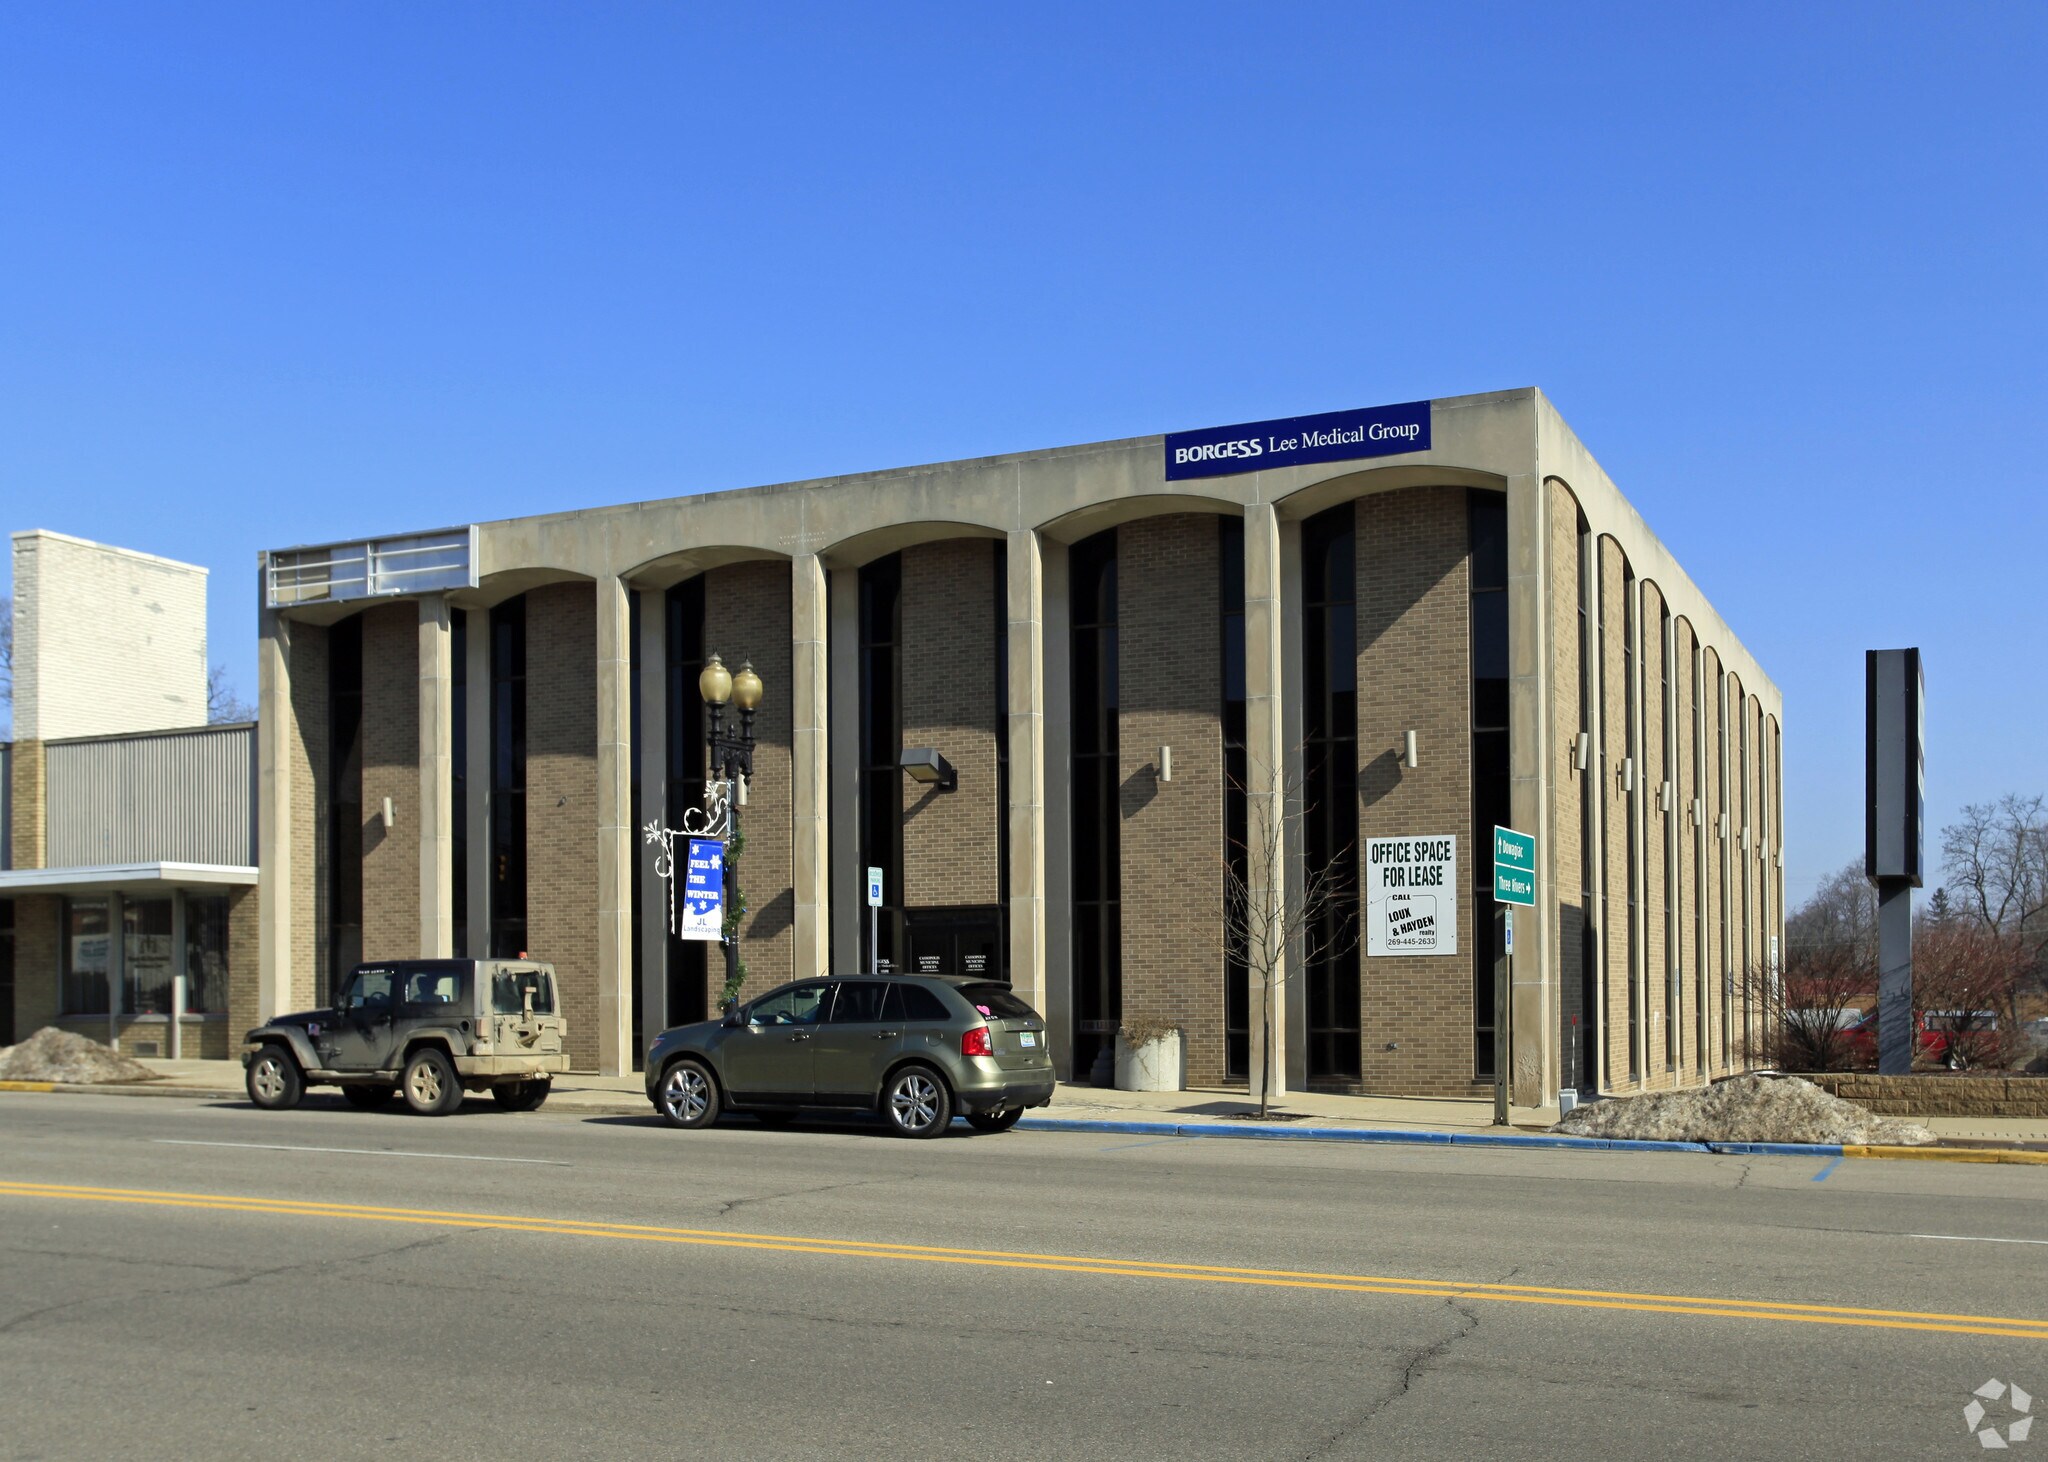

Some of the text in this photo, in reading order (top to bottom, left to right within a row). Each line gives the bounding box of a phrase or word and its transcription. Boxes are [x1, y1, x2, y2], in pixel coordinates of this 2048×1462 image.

[1175, 423, 1419, 464] BORGESS Lee Medical Group
[1372, 840, 1451, 864] OFFICE SPACE
[1503, 840, 1523, 860] Dowagiac
[690, 859, 709, 869] FEEL
[689, 875, 706, 884] THE
[1383, 865, 1443, 888] FOR LEASE
[1499, 875, 1525, 894] Three Rivers
[687, 889, 719, 900] WINTER
[1388, 907, 1412, 923] LOUX
[683, 926, 720, 935] Landscaping
[1392, 915, 1435, 937] & HAYDEN
[1387, 937, 1436, 946] 269-445-2633
